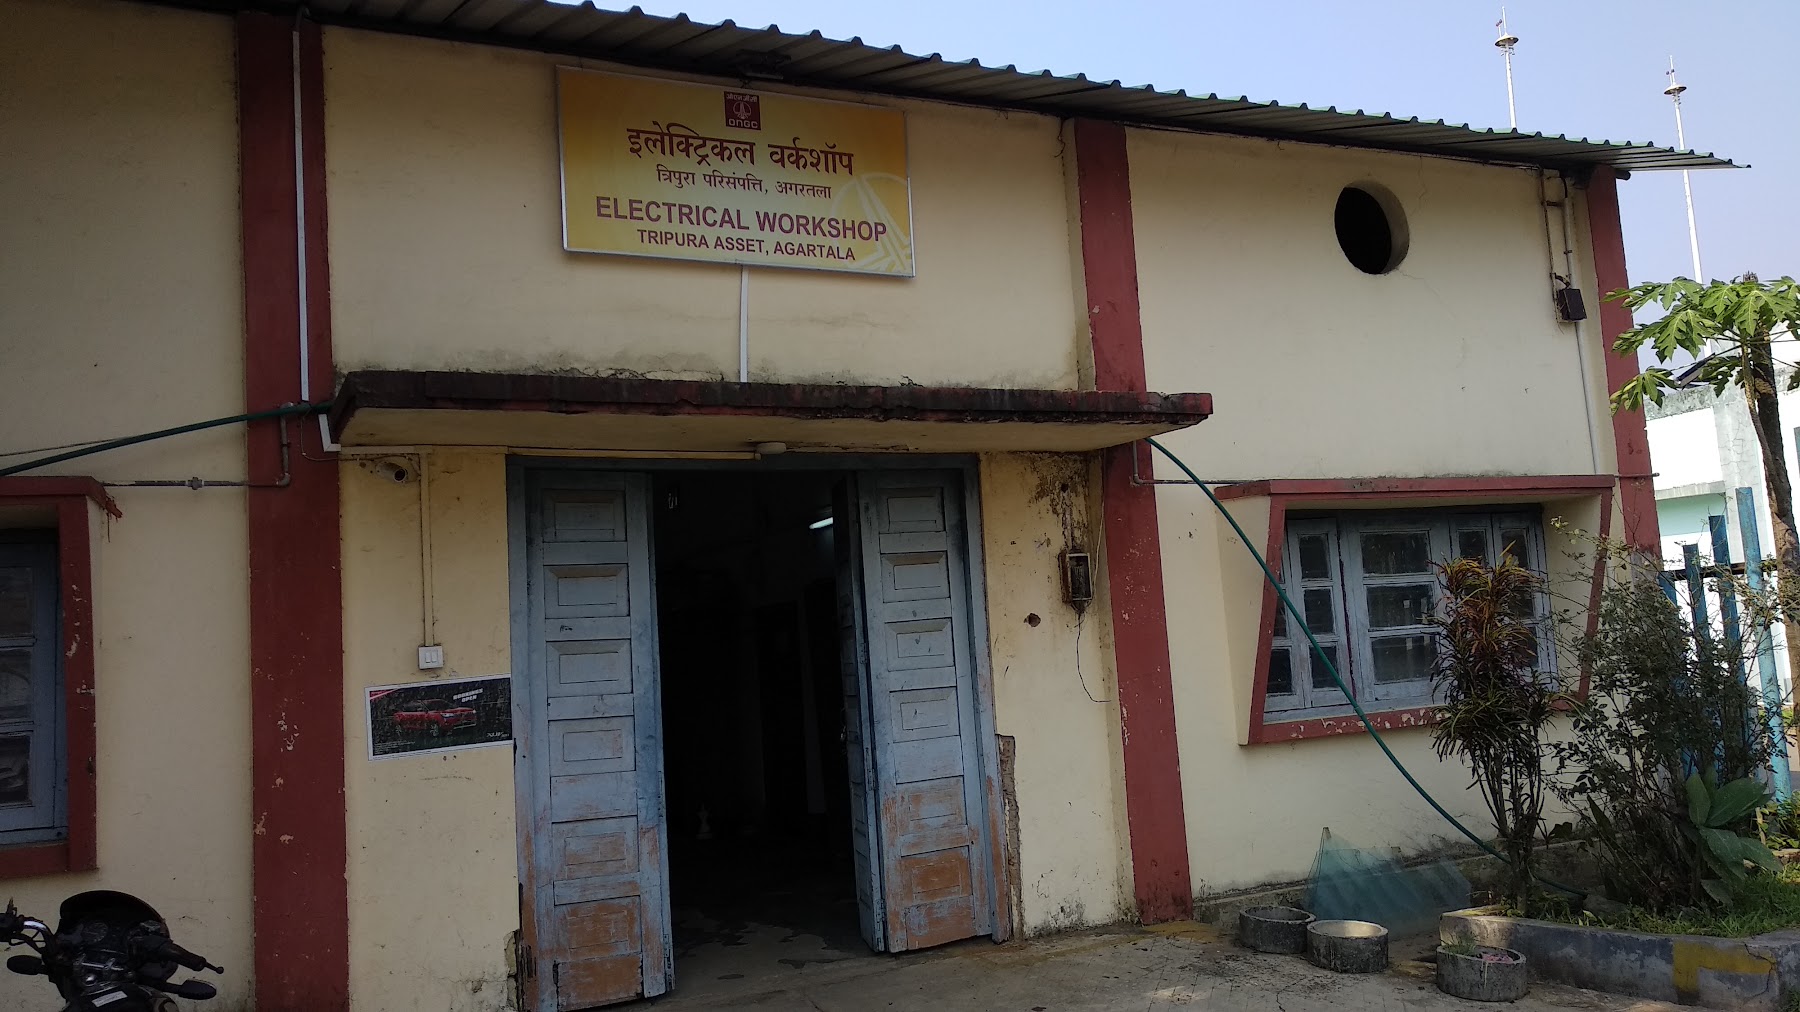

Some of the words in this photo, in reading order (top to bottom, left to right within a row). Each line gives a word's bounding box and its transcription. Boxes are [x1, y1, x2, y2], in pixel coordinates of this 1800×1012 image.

[728, 118, 759, 129] ONGC
[626, 121, 756, 166] इलेक्ट्रिकल
[768, 137, 854, 175] वर्कशॉप
[656, 164, 696, 189] त्रिपुरा
[702, 171, 768, 196] परिसंपत्ति,
[774, 181, 832, 199] अगरतला
[596, 196, 750, 231] ELECTRICAL
[755, 211, 887, 242] WORKSHOP
[637, 229, 709, 249] TRIPURA
[713, 236, 770, 256] ASSET,
[773, 241, 856, 261] AGARTALA
